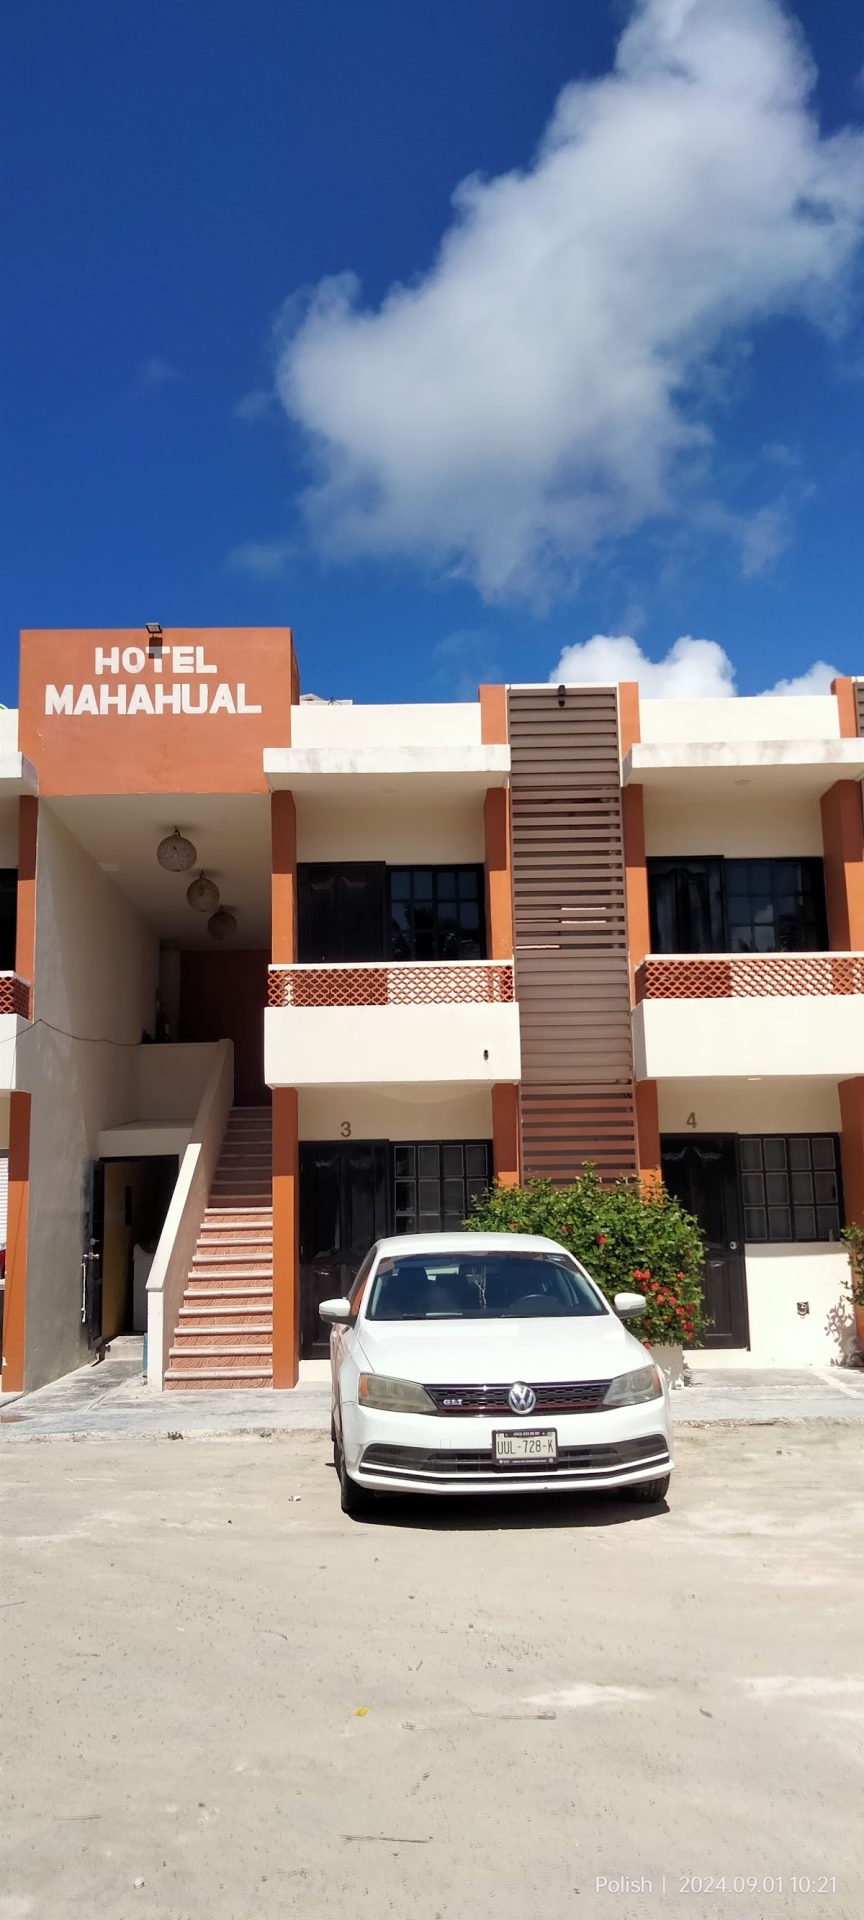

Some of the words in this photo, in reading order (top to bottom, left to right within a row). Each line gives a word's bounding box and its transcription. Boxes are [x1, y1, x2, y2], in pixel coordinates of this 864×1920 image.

[95, 646, 217, 675] HOTEL
[45, 683, 262, 715] MAHAHUAL
[686, 1112, 698, 1128] 4
[340, 1121, 352, 1137] 3
[443, 1398, 463, 1406] GLI
[497, 1439, 554, 1455] UUL-728-K
